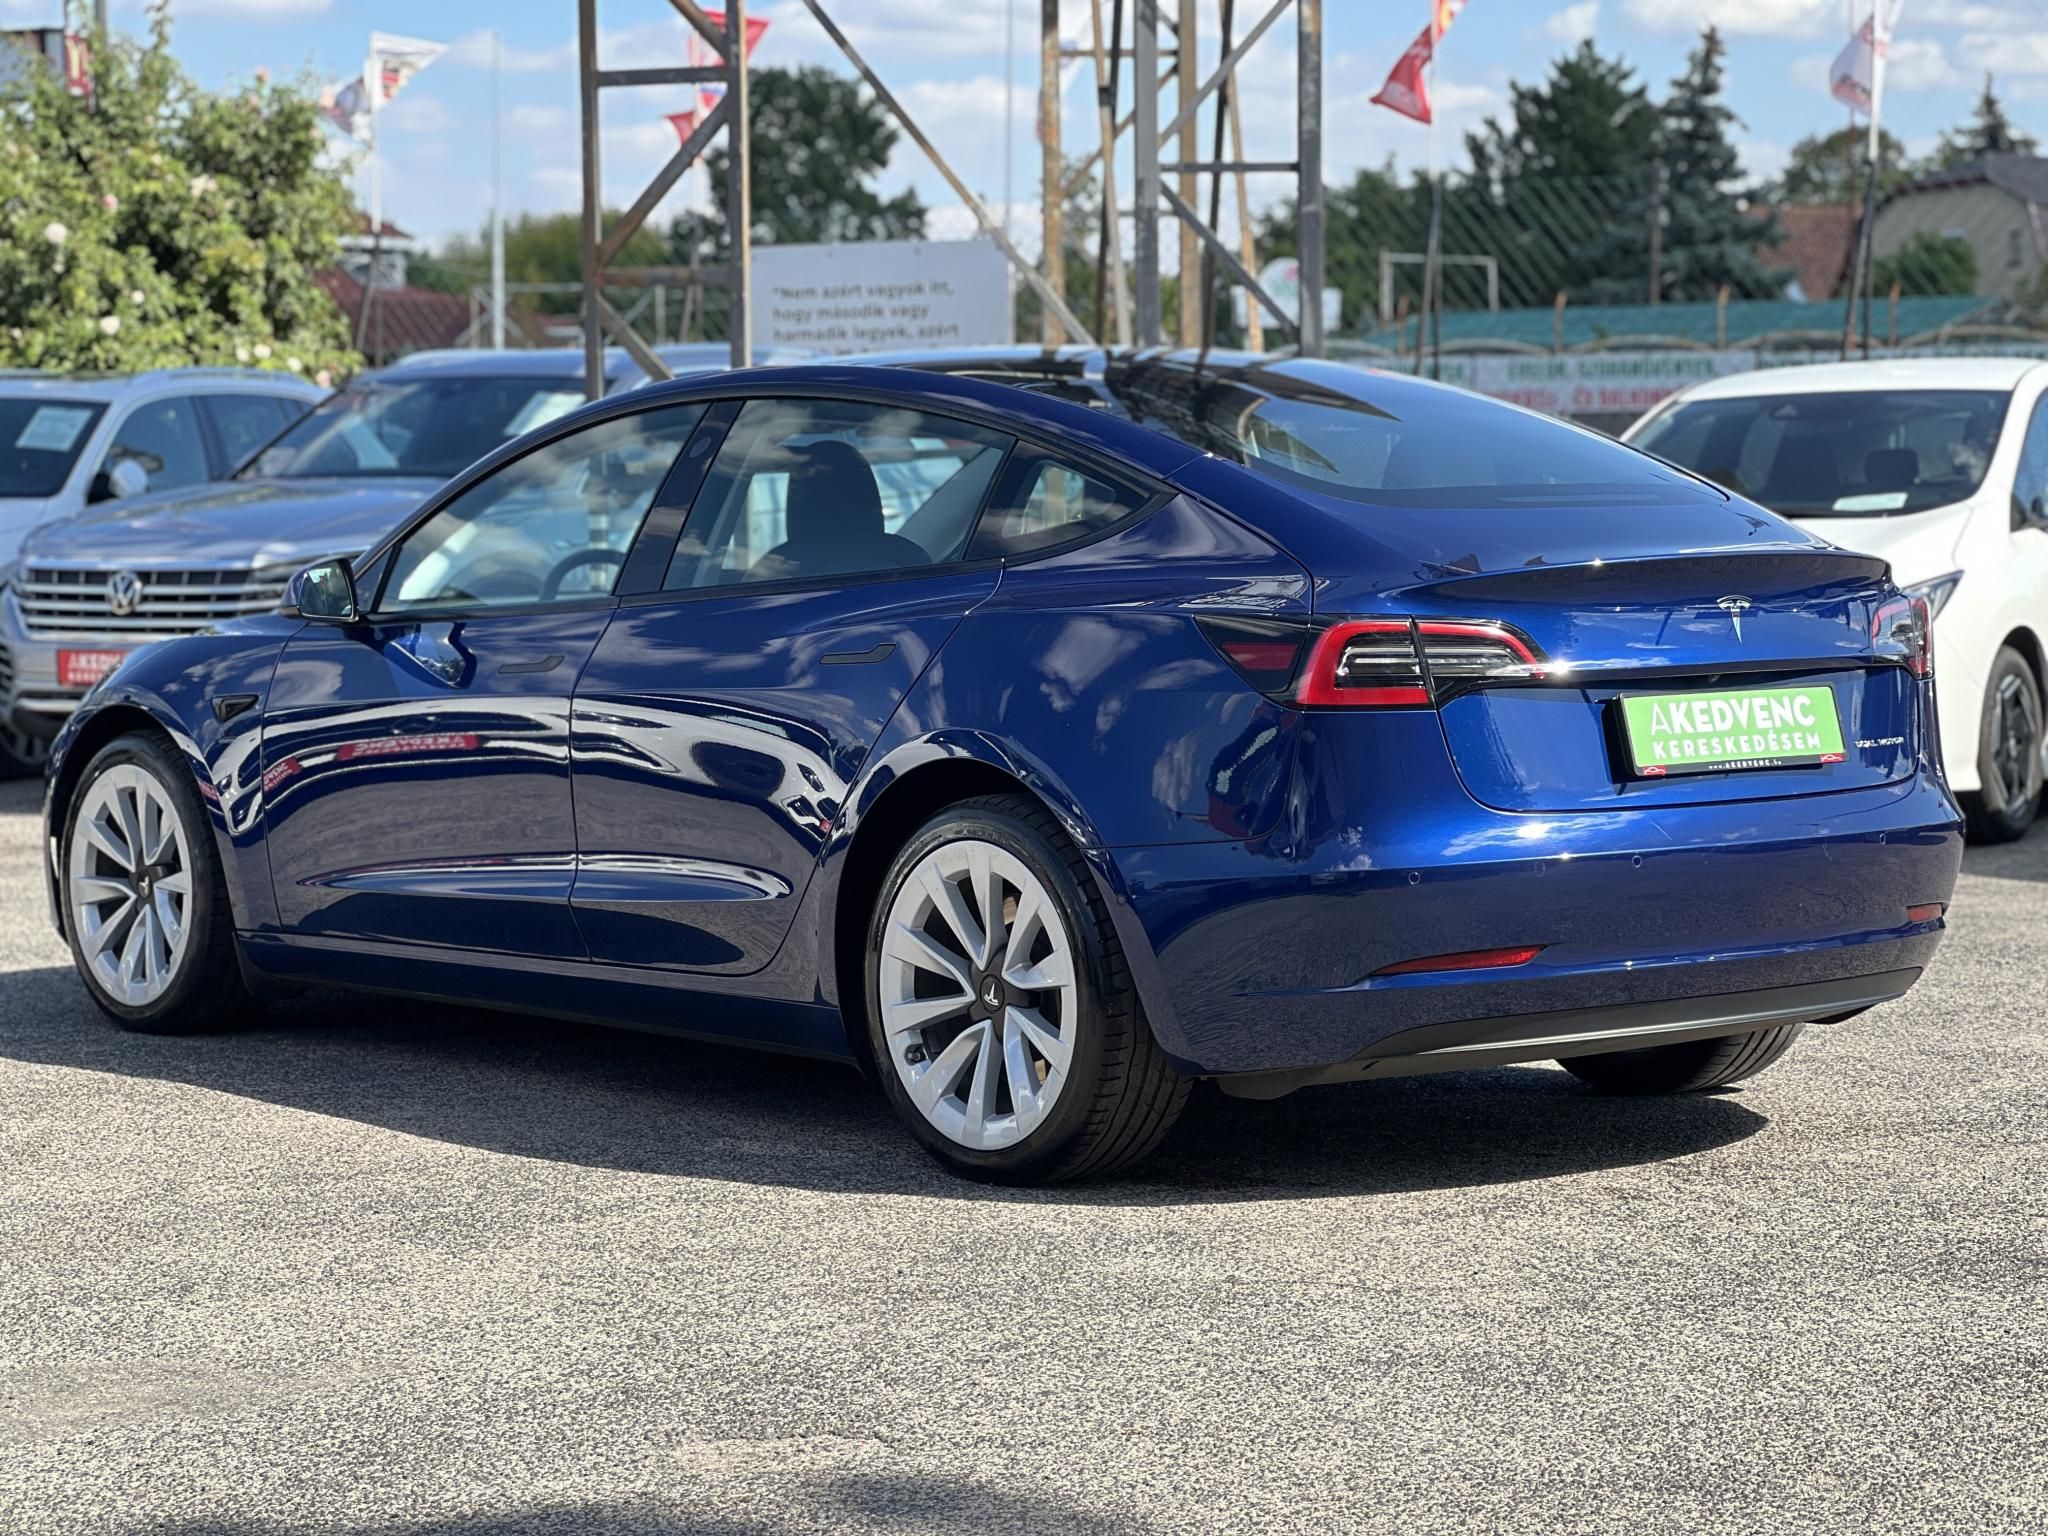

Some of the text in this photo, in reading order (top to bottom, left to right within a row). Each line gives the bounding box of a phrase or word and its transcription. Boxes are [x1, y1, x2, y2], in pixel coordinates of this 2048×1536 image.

[867, 279, 923, 300] vagyok
[772, 303, 930, 323] hogy második vagy
[772, 327, 848, 341] harmadik
[1651, 695, 1816, 736] AKEDVENC
[1652, 729, 1822, 760] KERESKEDÉSEM
